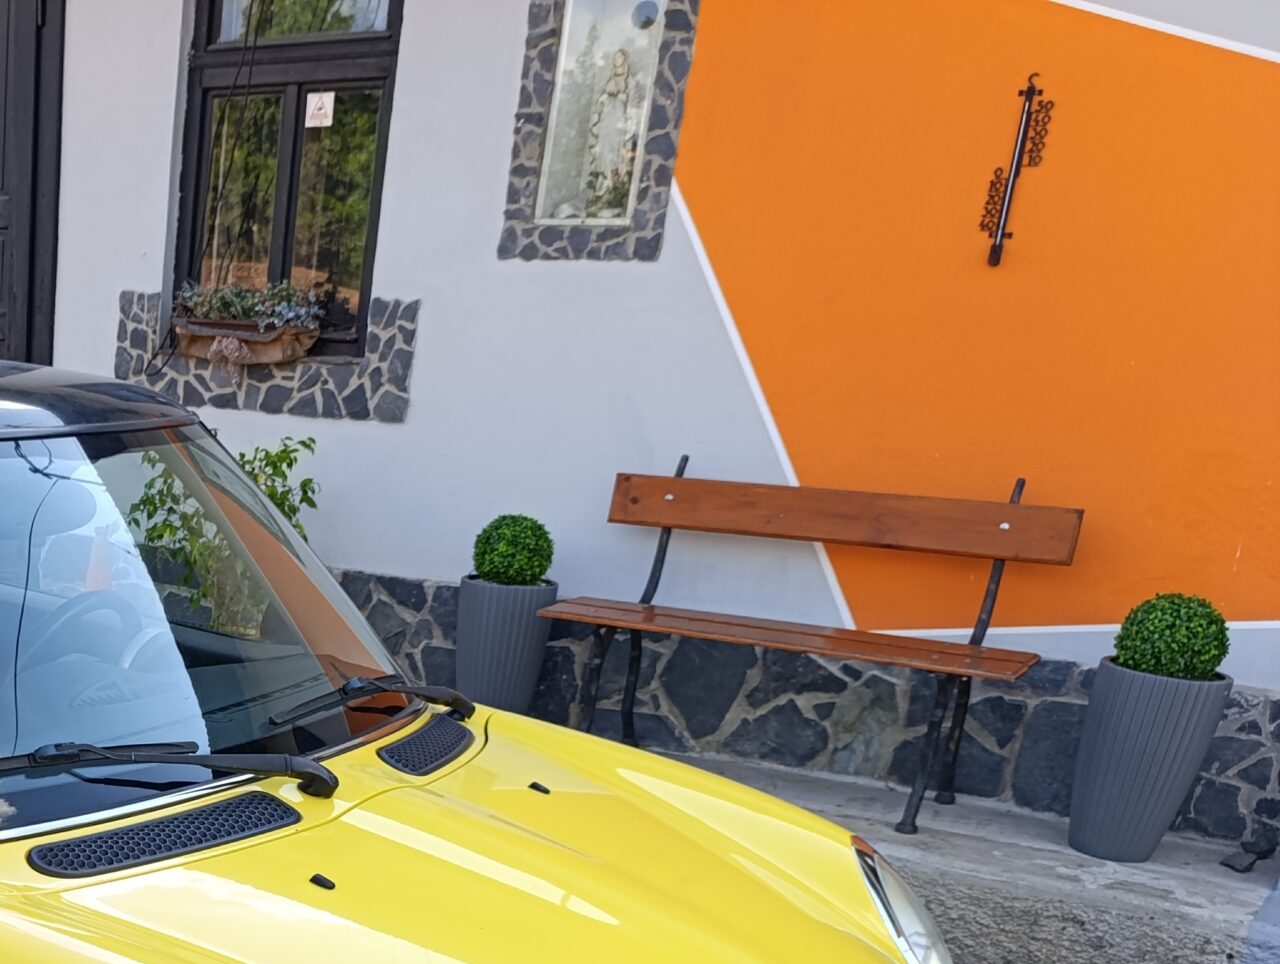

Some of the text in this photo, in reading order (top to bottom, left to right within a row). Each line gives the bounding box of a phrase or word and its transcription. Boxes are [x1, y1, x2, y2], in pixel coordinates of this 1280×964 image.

[1037, 100, 1054, 112] 50
[1028, 154, 1042, 166] 10
[994, 167, 1003, 179] 0
[990, 180, 1003, 191] 10
